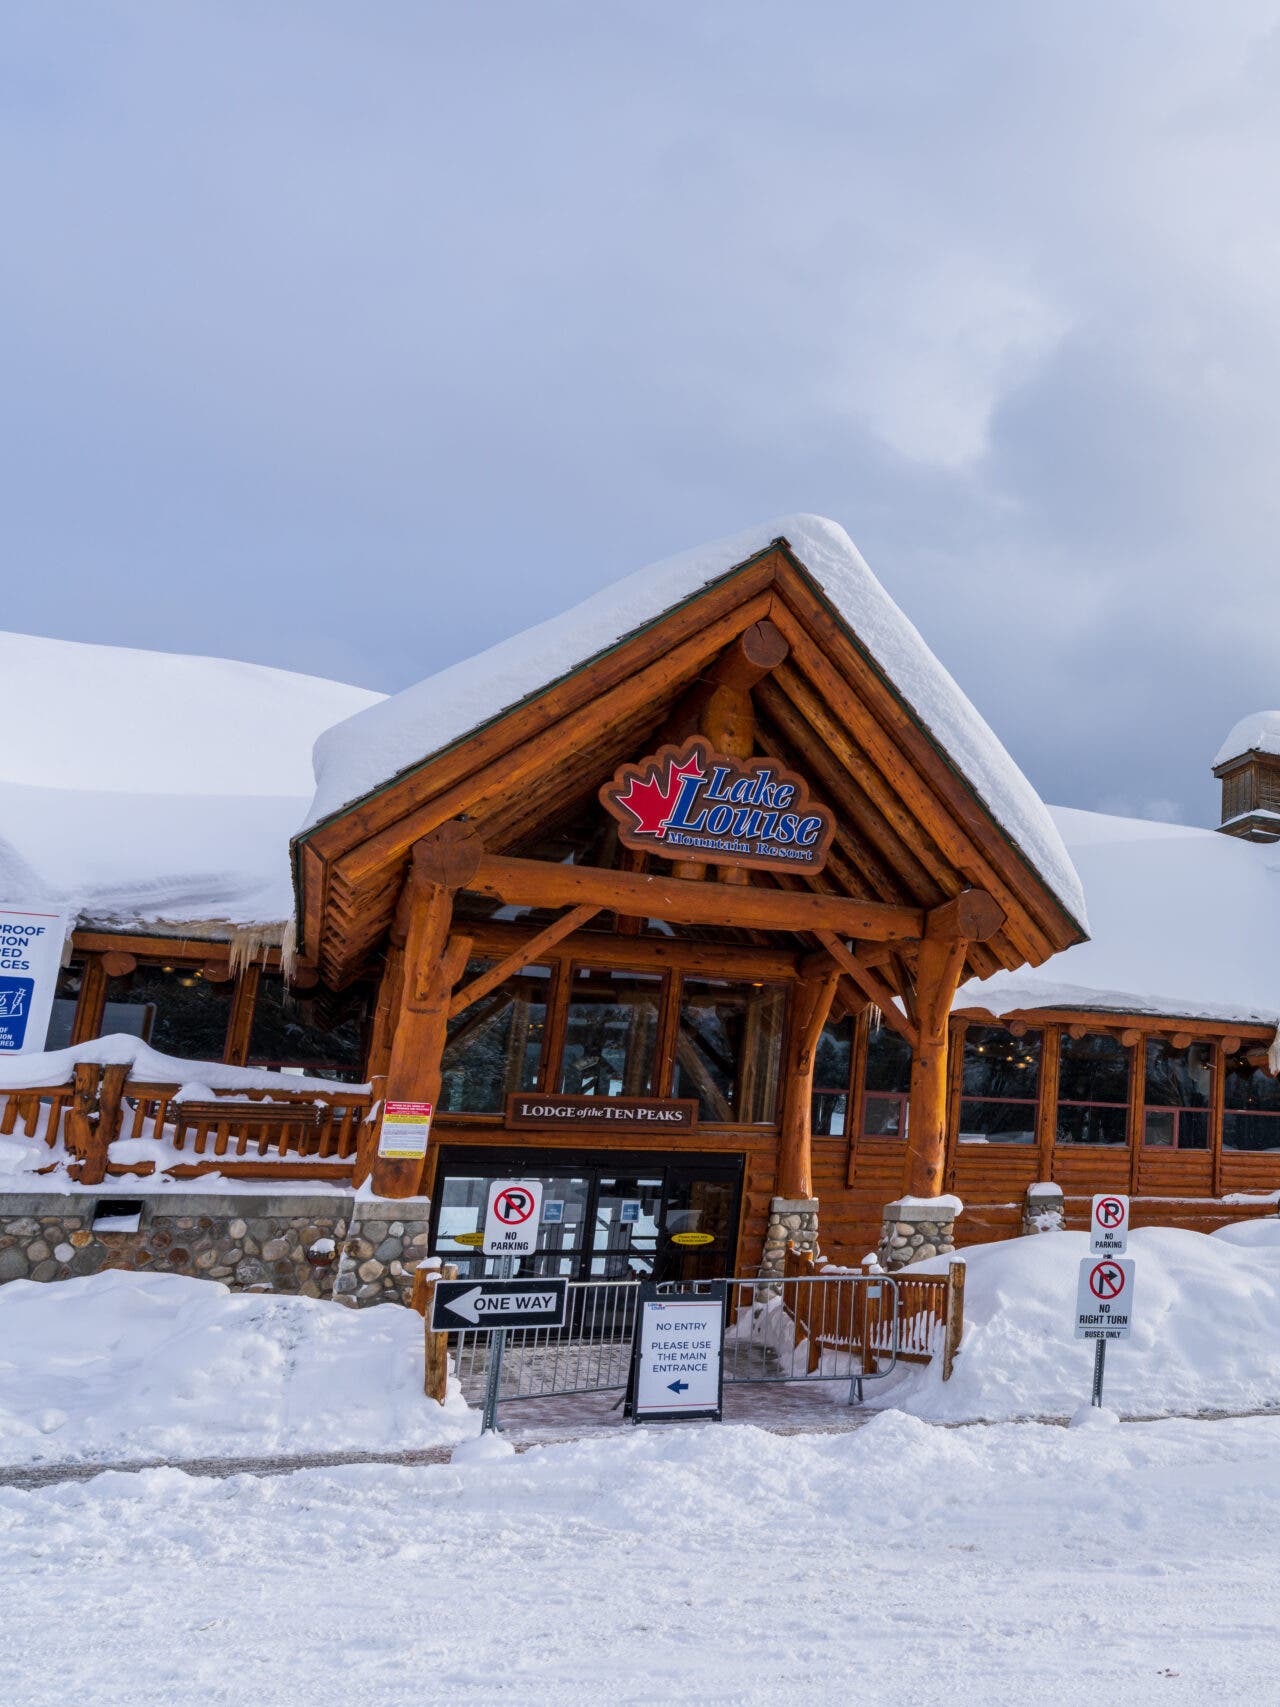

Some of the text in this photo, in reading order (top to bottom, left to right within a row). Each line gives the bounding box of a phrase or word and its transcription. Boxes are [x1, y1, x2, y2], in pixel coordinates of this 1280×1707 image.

[703, 766, 794, 809] Lake
[662, 773, 822, 845] Louise
[667, 831, 813, 860] Mountain Resort
[521, 1104, 576, 1118] LODGE
[603, 1107, 634, 1120] TEN
[637, 1108, 683, 1121] PEAKS
[505, 1232, 517, 1240] NO
[491, 1241, 529, 1250] PARKING
[474, 1296, 552, 1310] ONE WAY
[1099, 1304, 1110, 1313] NO
[1080, 1315, 1128, 1325] RIGHT TURN
[656, 1322, 707, 1331] NO ENTRY
[651, 1341, 712, 1350] PLEASE USE
[680, 1352, 707, 1360] MAIN
[652, 1363, 708, 1372] ENTRANCE
